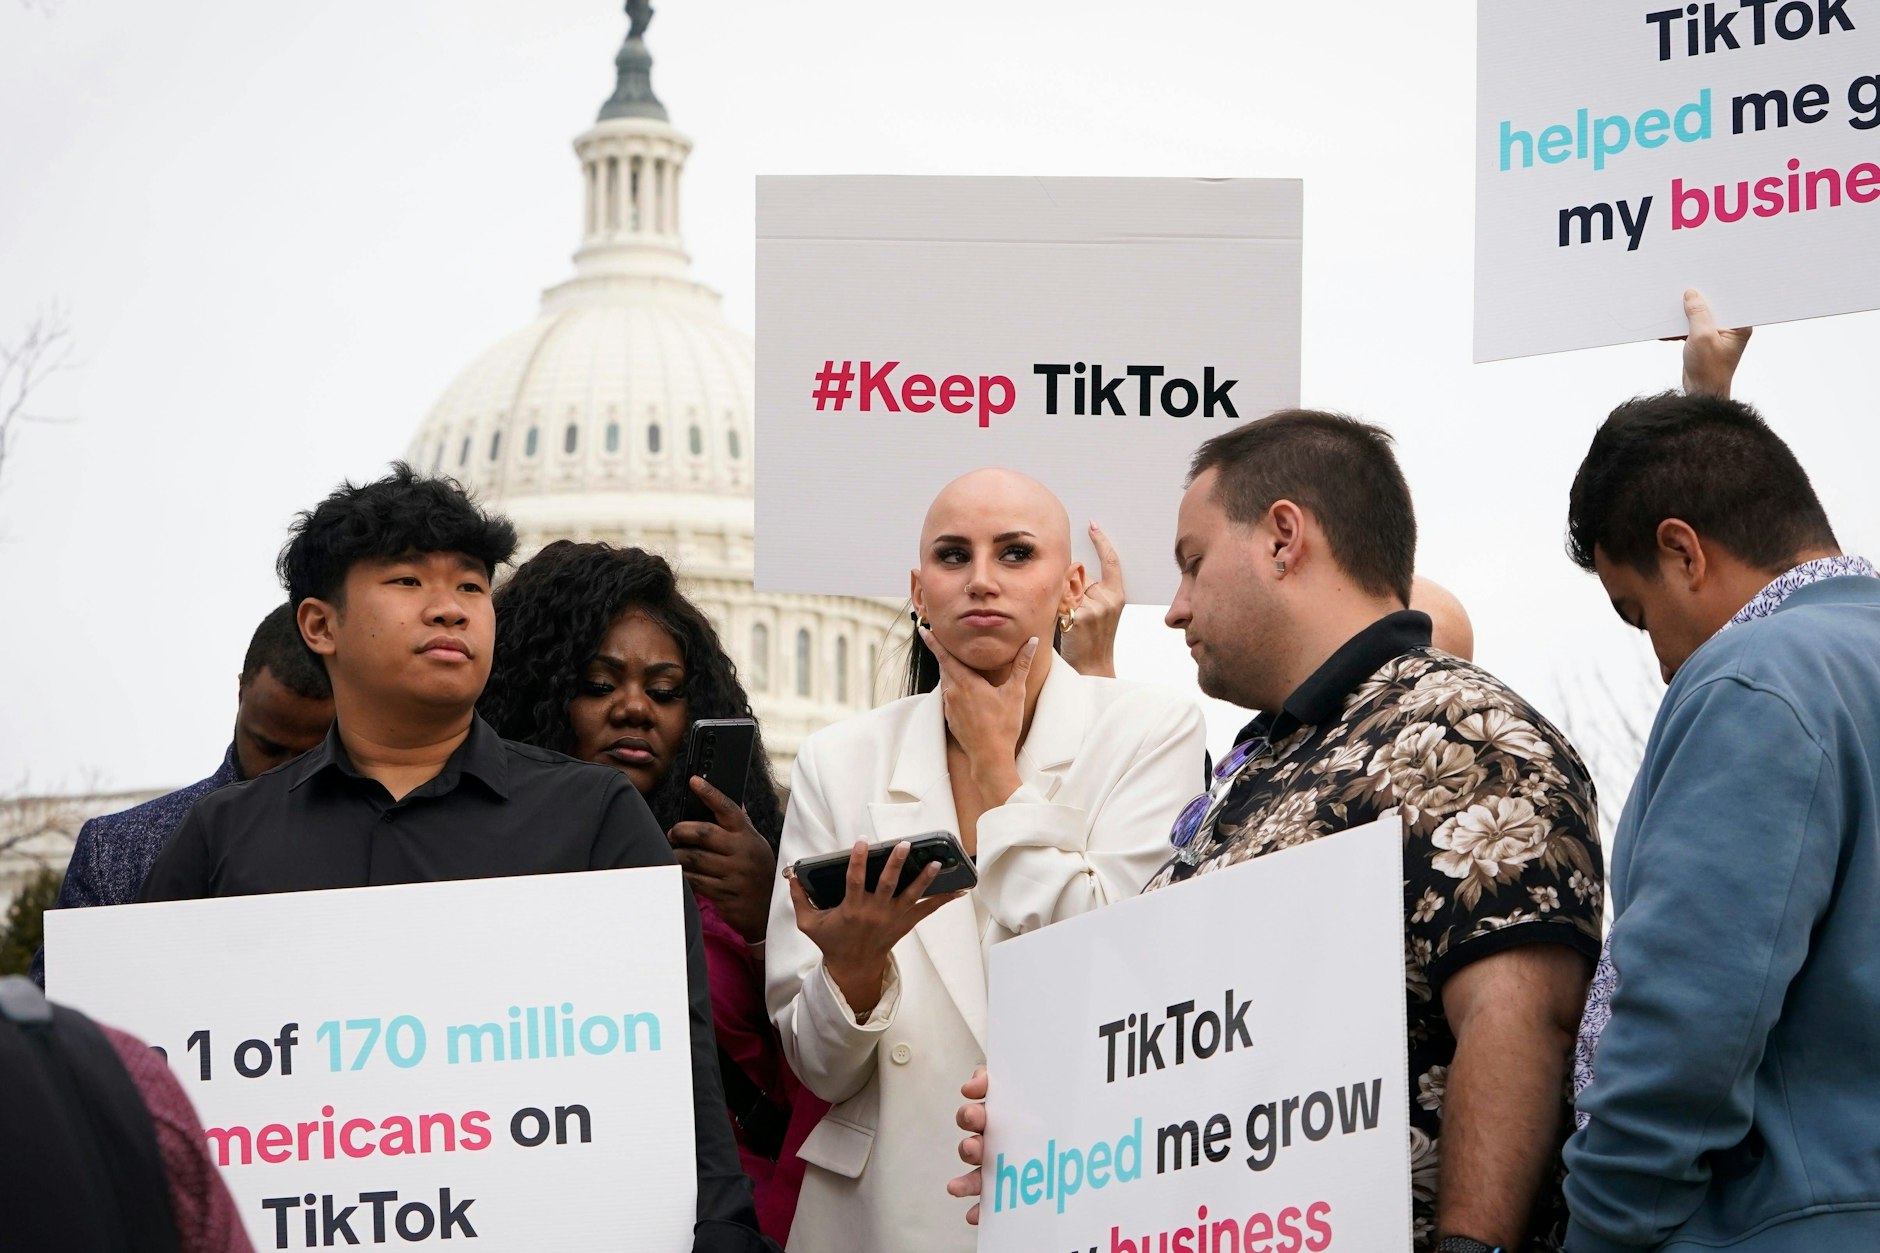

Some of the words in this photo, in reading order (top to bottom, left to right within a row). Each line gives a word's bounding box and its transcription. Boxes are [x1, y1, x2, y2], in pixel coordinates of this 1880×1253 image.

[1645, 0, 1856, 61] TikTok
[1499, 88, 1712, 171] helped
[1732, 83, 1830, 135] me
[1558, 196, 1654, 252] my
[812, 360, 1016, 428] #Keep
[1033, 361, 1240, 419] TikTok
[186, 1029, 212, 1081] 1
[233, 1022, 299, 1079] of
[316, 1015, 426, 1072] 170
[447, 1003, 661, 1064] million
[1098, 989, 1254, 1084] TikTok
[204, 1105, 492, 1167] mericans
[509, 1103, 592, 1148] on
[993, 1117, 1143, 1214] helped
[1156, 1113, 1232, 1175] me
[1245, 1078, 1383, 1172] grow
[262, 1187, 478, 1250] TikTok
